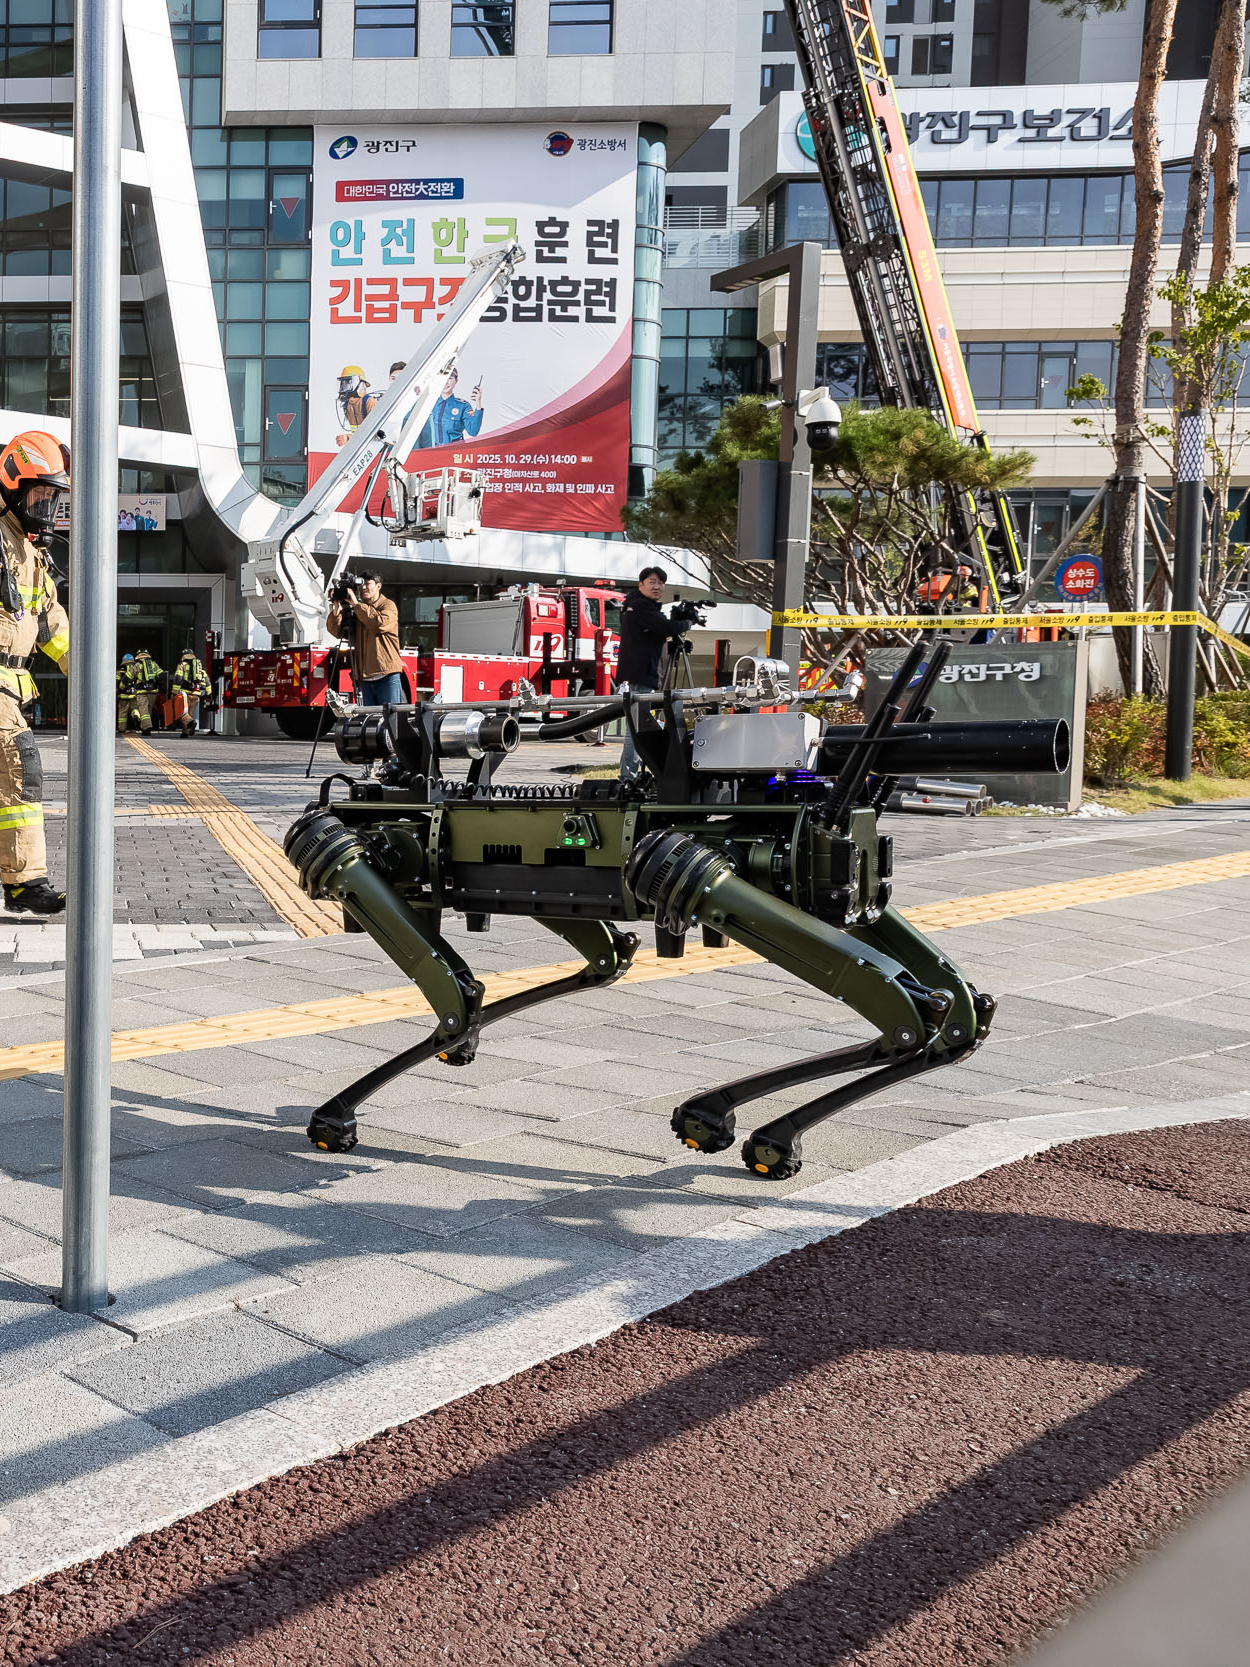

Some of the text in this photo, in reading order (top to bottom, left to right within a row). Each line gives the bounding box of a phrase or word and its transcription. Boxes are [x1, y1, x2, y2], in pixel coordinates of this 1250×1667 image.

[363, 139, 418, 153] 광진구
[576, 138, 627, 151] 광진소방서
[343, 181, 455, 198] 대한민국 안전大전환
[918, 249, 933, 282] 53M
[352, 450, 374, 477] EAP28
[477, 453, 501, 464] 2025.
[504, 453, 517, 464] 10.
[519, 453, 549, 465] 29.(수)
[551, 454, 577, 464] 14:00
[504, 483, 523, 493] 인적
[524, 483, 545, 494] 사고,
[546, 483, 564, 494] 화재
[565, 483, 575, 494] 및
[576, 484, 595, 494] 인파
[596, 484, 615, 494] 사고
[1067, 568, 1095, 578] 상수도
[1065, 579, 1095, 589] 소화전
[939, 662, 1041, 683] 광진구청
